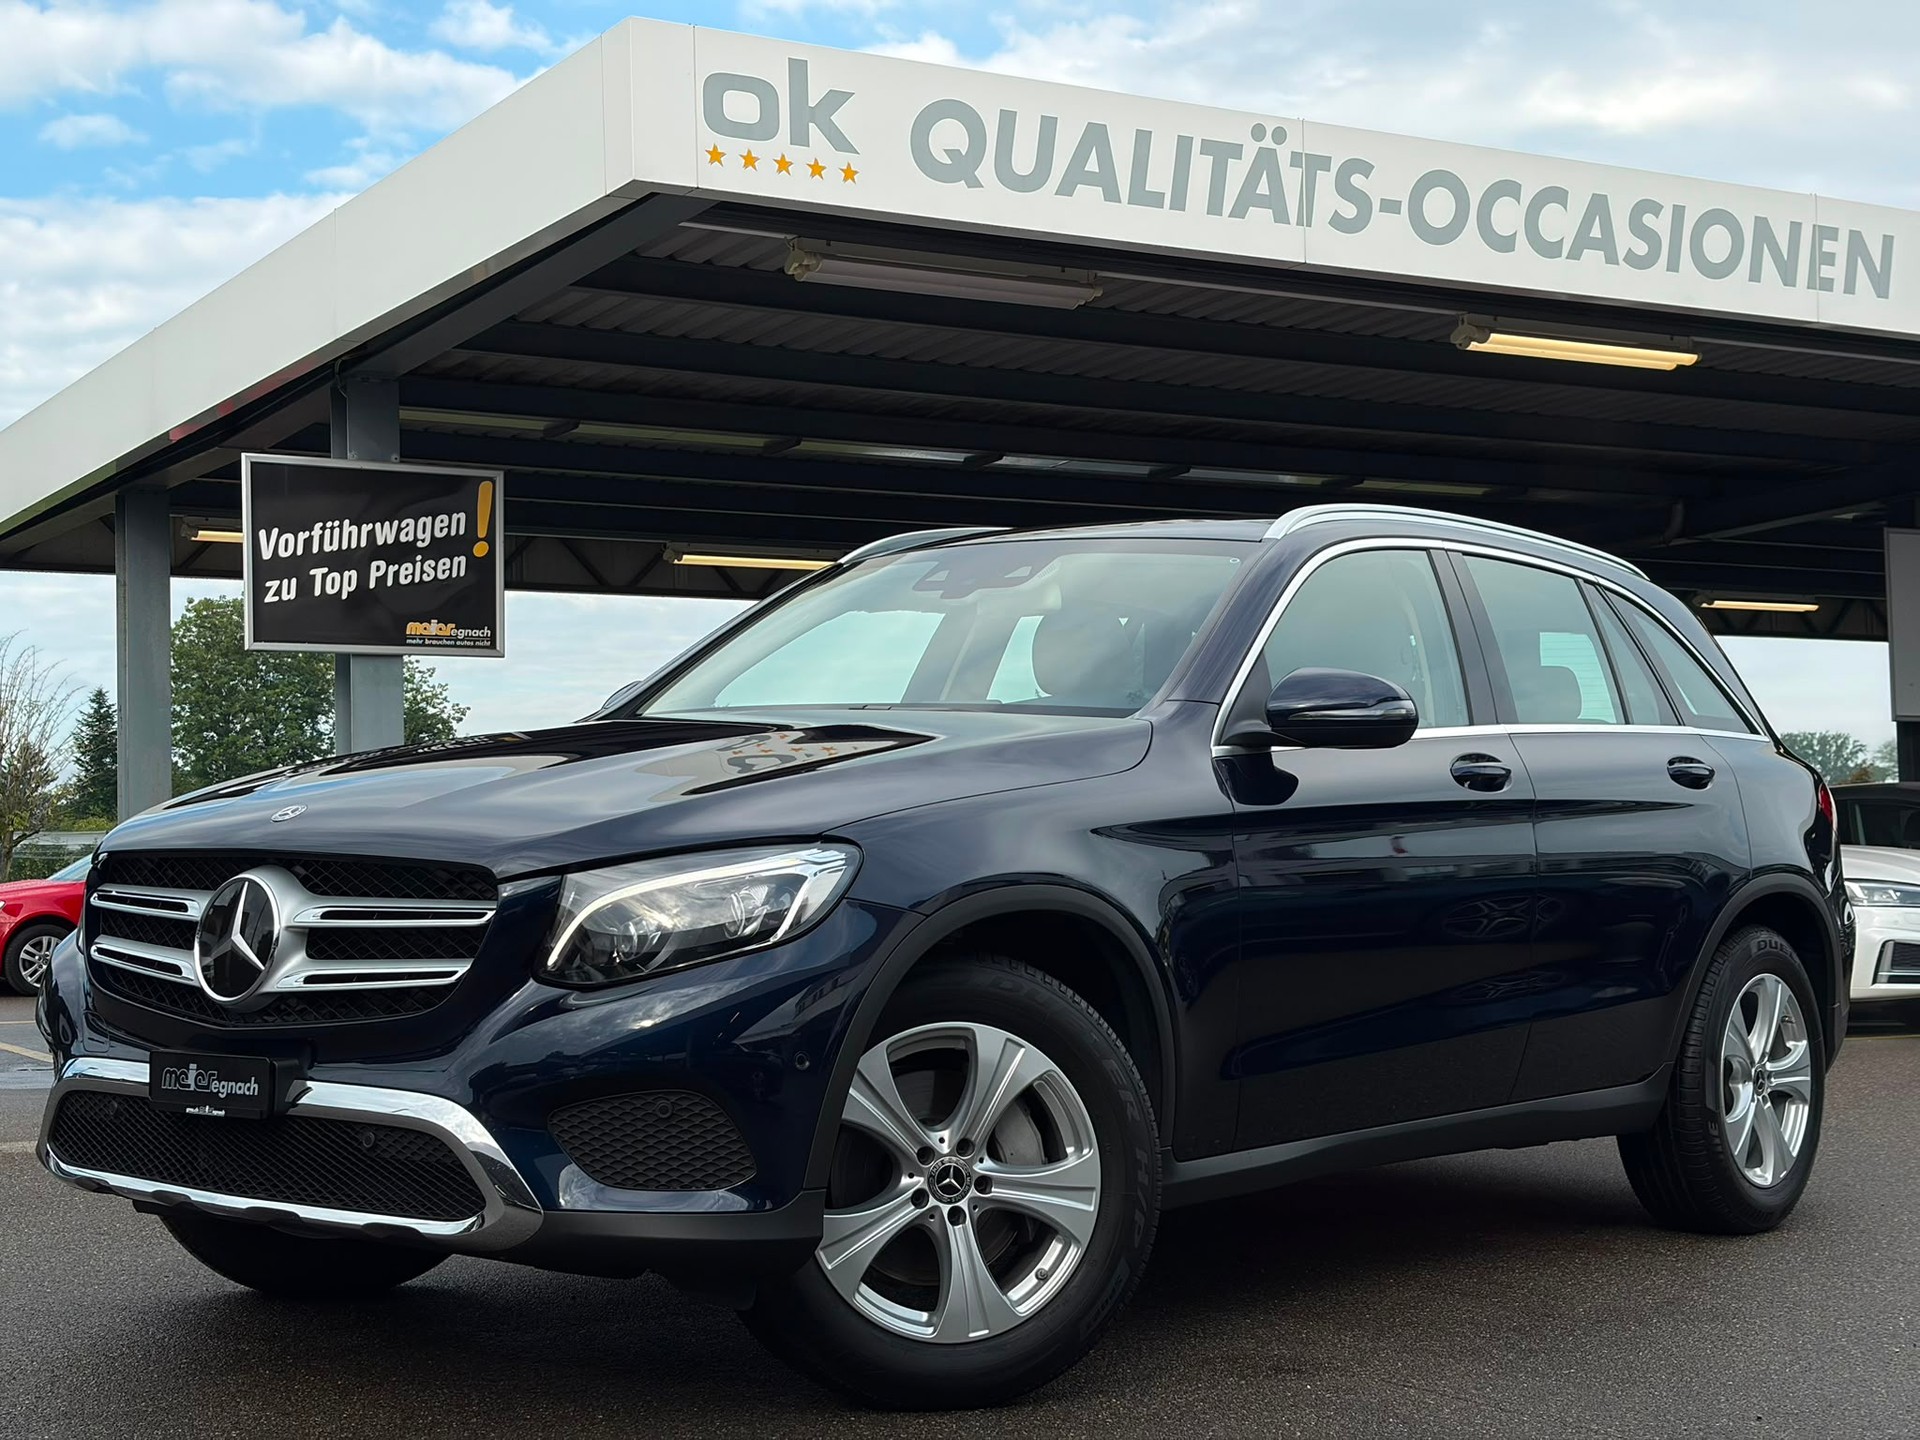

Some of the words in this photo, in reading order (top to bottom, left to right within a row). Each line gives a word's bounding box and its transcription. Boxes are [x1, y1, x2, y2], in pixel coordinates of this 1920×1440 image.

[702, 57, 860, 155] ok
[910, 98, 1894, 299] QUALITÄTS-OCCASIONEN
[258, 511, 467, 560] Vorführwagen
[264, 577, 297, 603] zu
[309, 565, 358, 600] Top
[368, 554, 467, 590] Preisen
